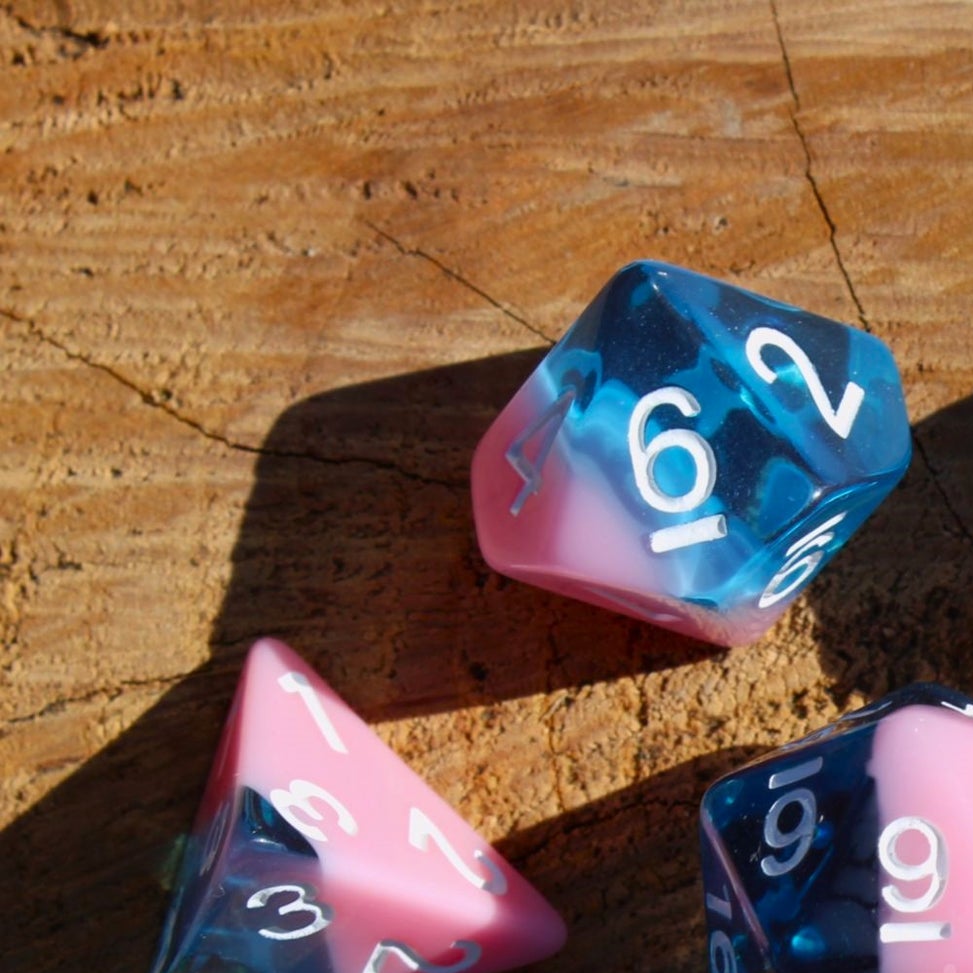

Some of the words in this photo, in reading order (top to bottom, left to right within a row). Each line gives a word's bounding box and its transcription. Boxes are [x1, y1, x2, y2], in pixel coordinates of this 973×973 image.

[746, 327, 865, 439] 2
[505, 389, 576, 517] 4
[628, 387, 727, 553] 6
[277, 673, 350, 754] 1
[270, 780, 358, 842] 3
[246, 885, 334, 940] 3
[879, 816, 951, 943] 9
